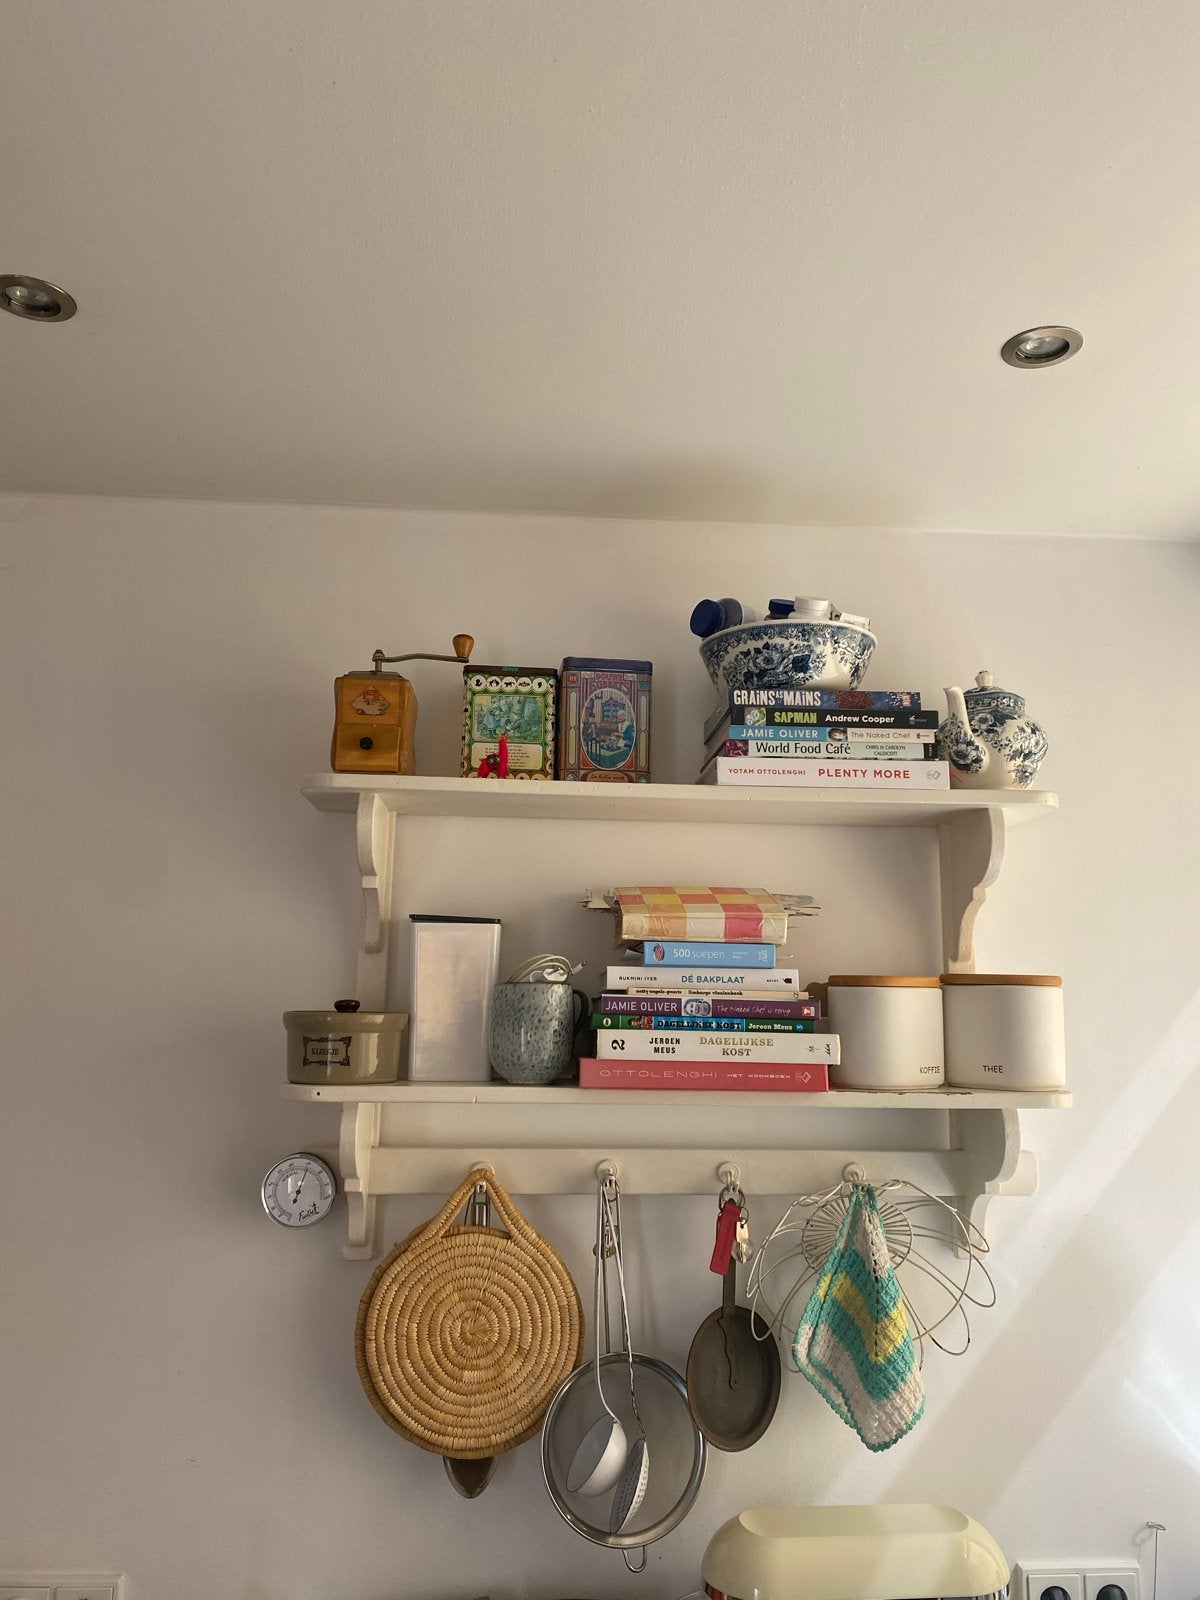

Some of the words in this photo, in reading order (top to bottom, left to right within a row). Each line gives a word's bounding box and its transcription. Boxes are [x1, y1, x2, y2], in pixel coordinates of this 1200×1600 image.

[774, 711, 818, 724] SAPMAN
[825, 714, 859, 723] Andrew
[860, 715, 895, 725] Cooper
[741, 729, 774, 738] JAMIE
[779, 729, 818, 739] OLIVER
[851, 731, 865, 739] The
[867, 731, 890, 739] Naked
[755, 742, 790, 754] World
[794, 743, 822, 755] Food
[826, 741, 851, 754] Café
[818, 768, 867, 779] PLENTY
[873, 769, 910, 779] MORE
[672, 948, 691, 958] 500
[691, 950, 725, 961] soepen
[681, 974, 694, 984] DÉ
[697, 975, 745, 984] BAKPLAAT
[605, 1001, 637, 1012] JAMIE
[640, 1002, 677, 1013] OLIVER
[717, 1004, 728, 1013] The
[752, 1005, 766, 1015] Chef
[657, 1019, 715, 1030] DAGELIJKSE
[717, 1021, 742, 1031] KOST
[748, 1022, 772, 1031] Jeroen
[774, 1023, 793, 1031] Meus
[611, 1039, 625, 1051] 2
[649, 1037, 680, 1046] JEROEN
[699, 1037, 774, 1047] DAGELIJKSE
[654, 1046, 676, 1054] MEUS
[722, 1048, 752, 1057] KOST
[600, 1070, 718, 1078] OTTOLENGHI
[920, 1066, 940, 1074] KOFFIE
[983, 1065, 1003, 1073] THEE
